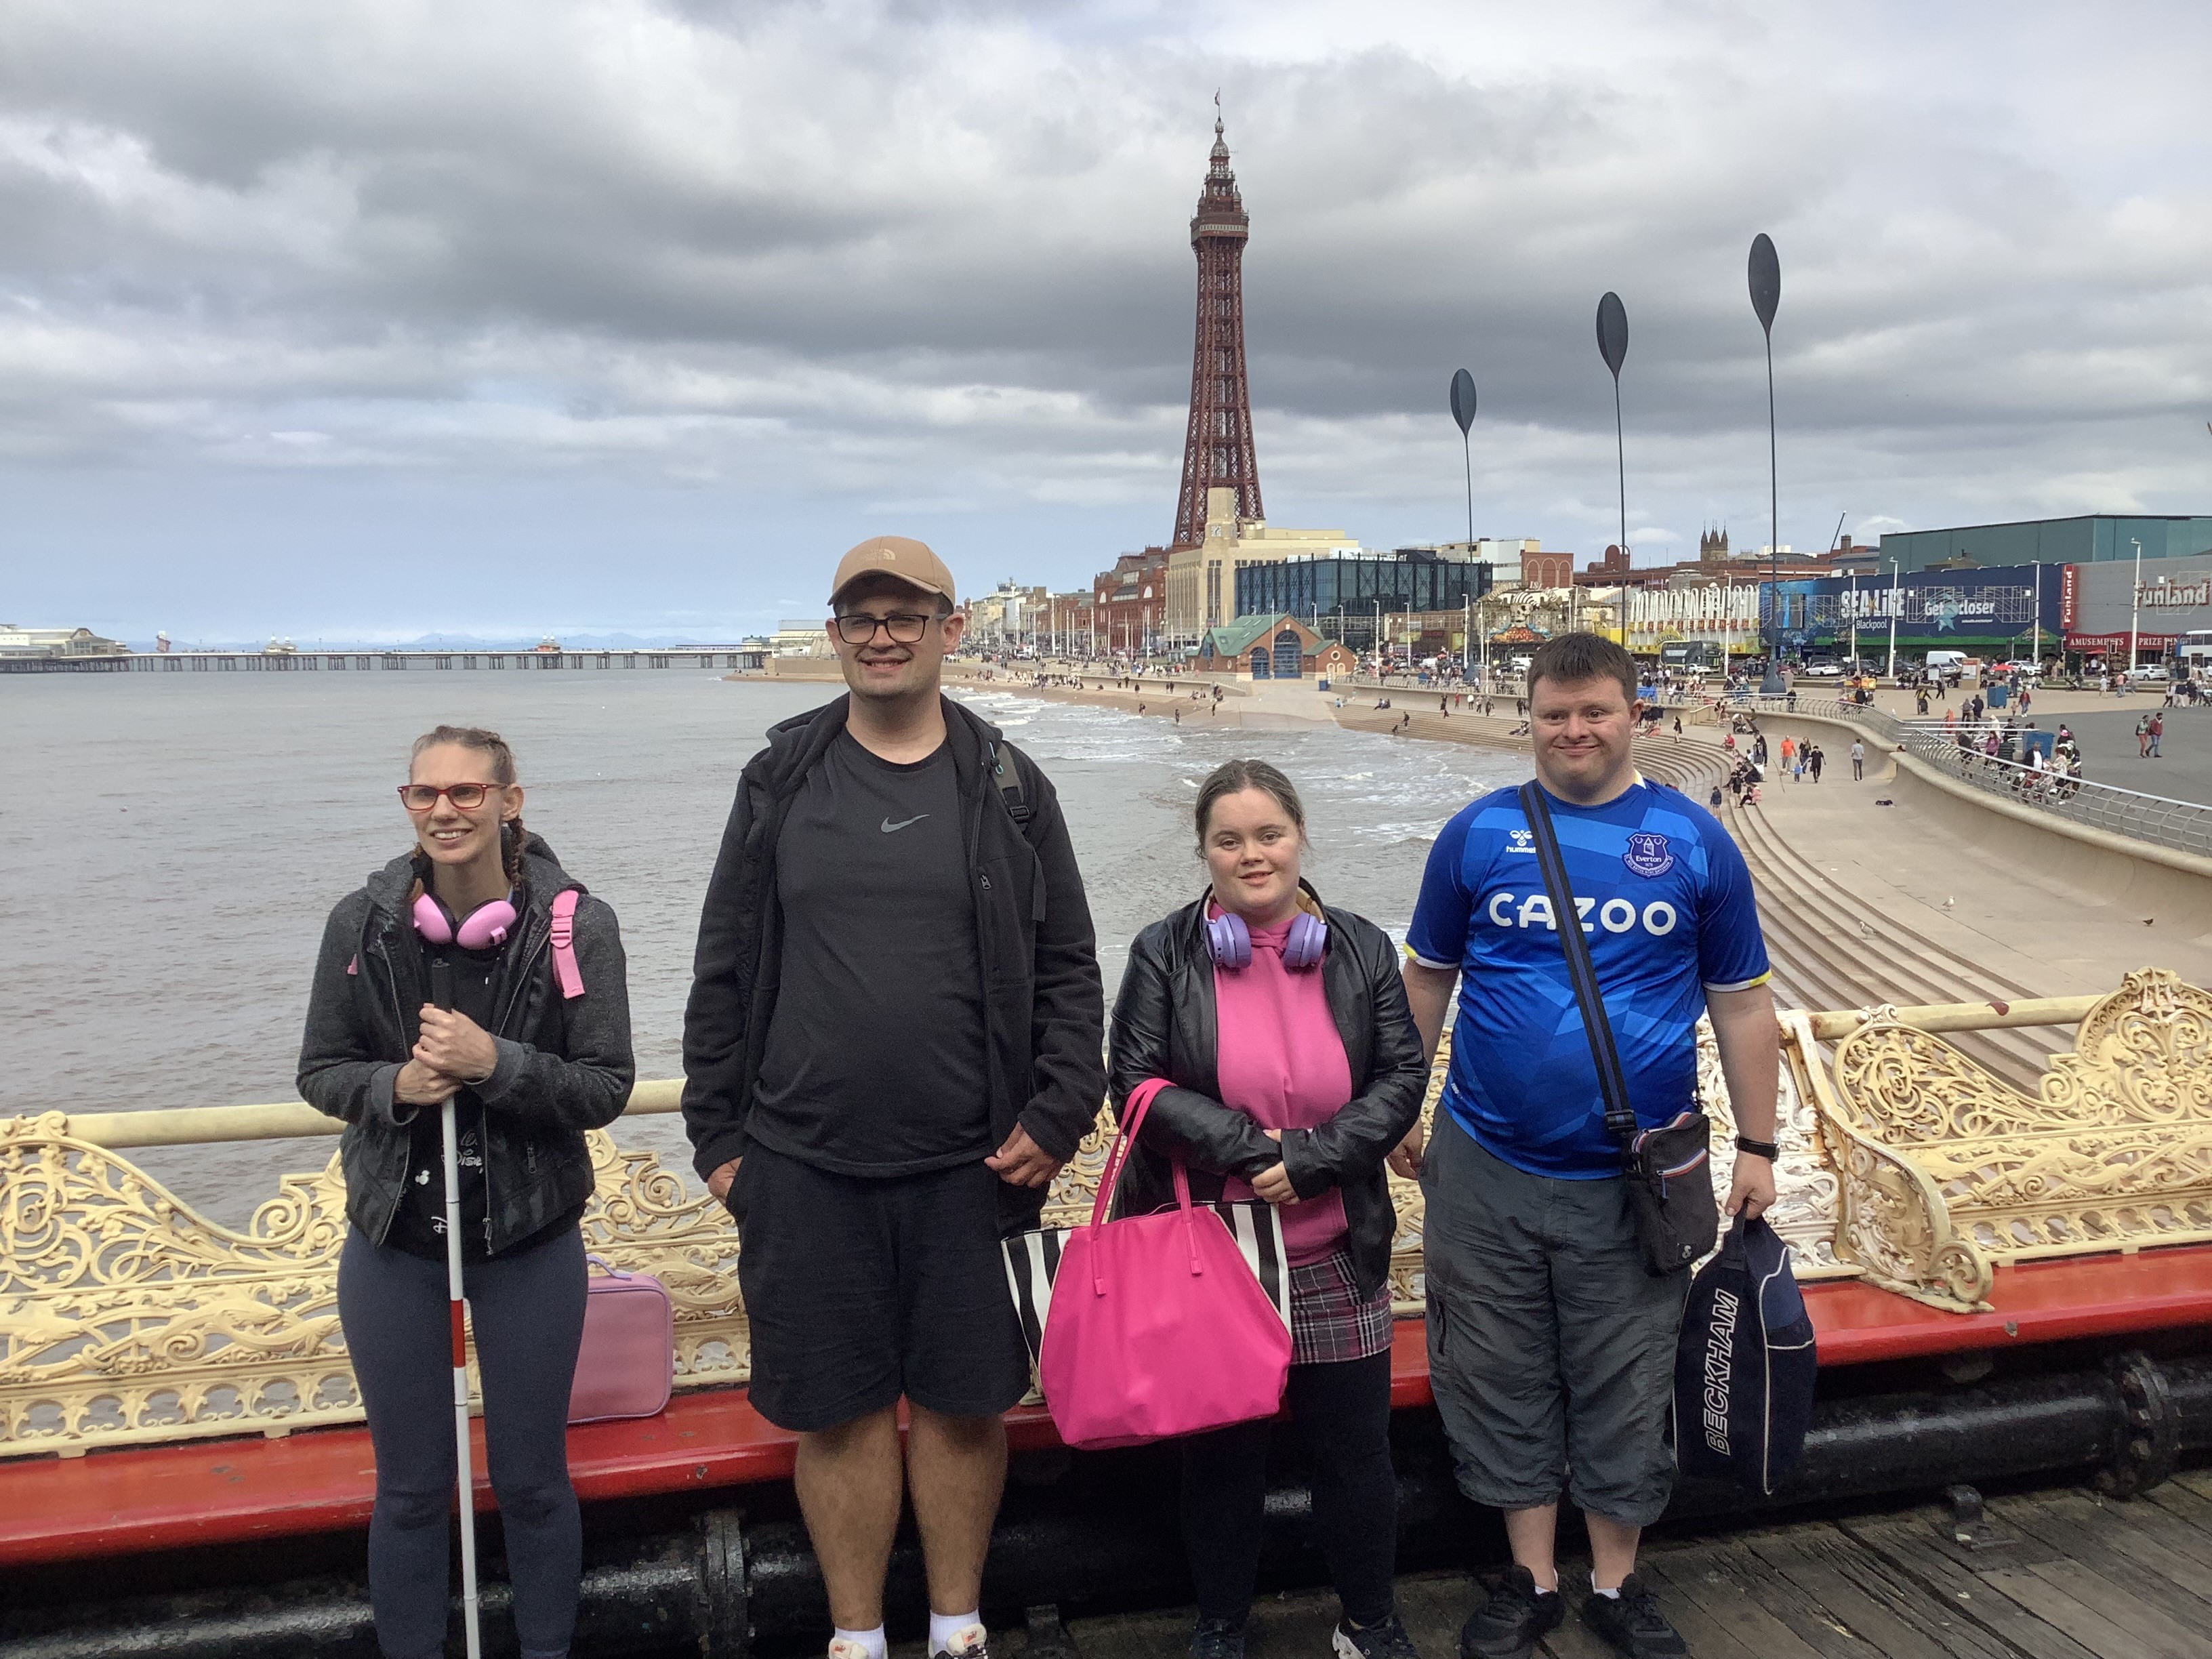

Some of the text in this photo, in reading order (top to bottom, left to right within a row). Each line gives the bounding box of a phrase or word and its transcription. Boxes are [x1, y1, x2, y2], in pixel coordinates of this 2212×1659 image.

[1841, 590, 1870, 619] SEA
[1925, 599, 1995, 616] Get closer
[2064, 571, 2072, 623] Funland
[1856, 619, 1887, 631] Blackpool
[2070, 637, 2124, 647] AMUSEMENTS
[2138, 637, 2163, 646] PRIZE
[1506, 845, 1536, 854] hummel
[1489, 892, 1677, 937] CAZOO
[1703, 1288, 1739, 1456] BECKHAM
